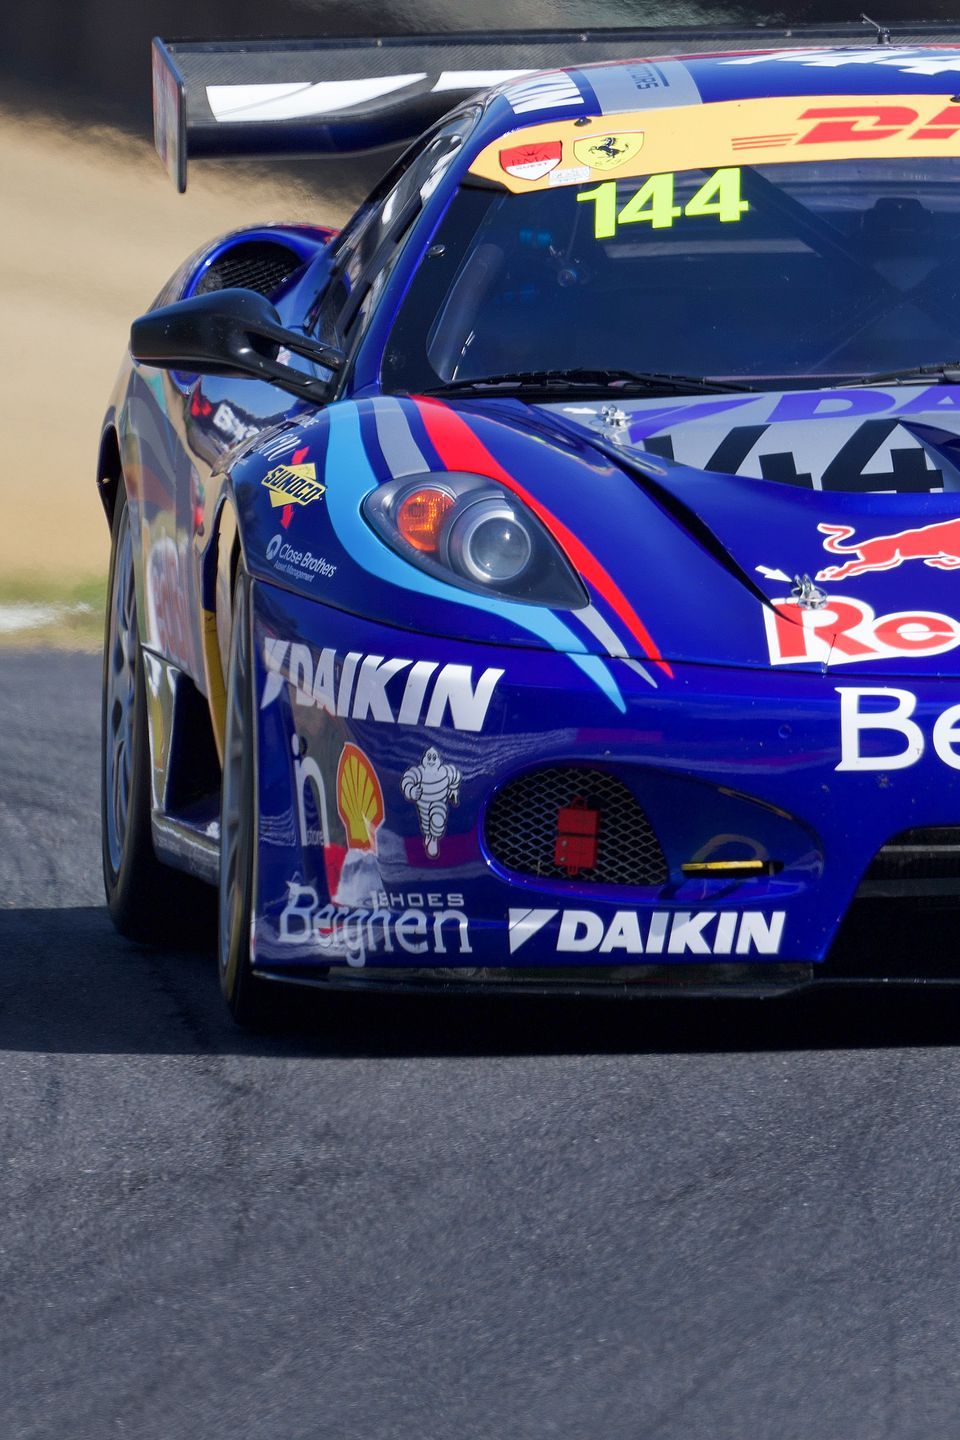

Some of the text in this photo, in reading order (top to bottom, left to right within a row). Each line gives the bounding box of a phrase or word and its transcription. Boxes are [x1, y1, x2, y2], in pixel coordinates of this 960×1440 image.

[576, 167, 749, 239] 144
[266, 467, 322, 502] SUNOCO
[279, 544, 337, 577] Close Brothers
[288, 642, 505, 732] DAIKIN
[278, 880, 473, 967] Berghen
[557, 910, 786, 955] DAIKIN
